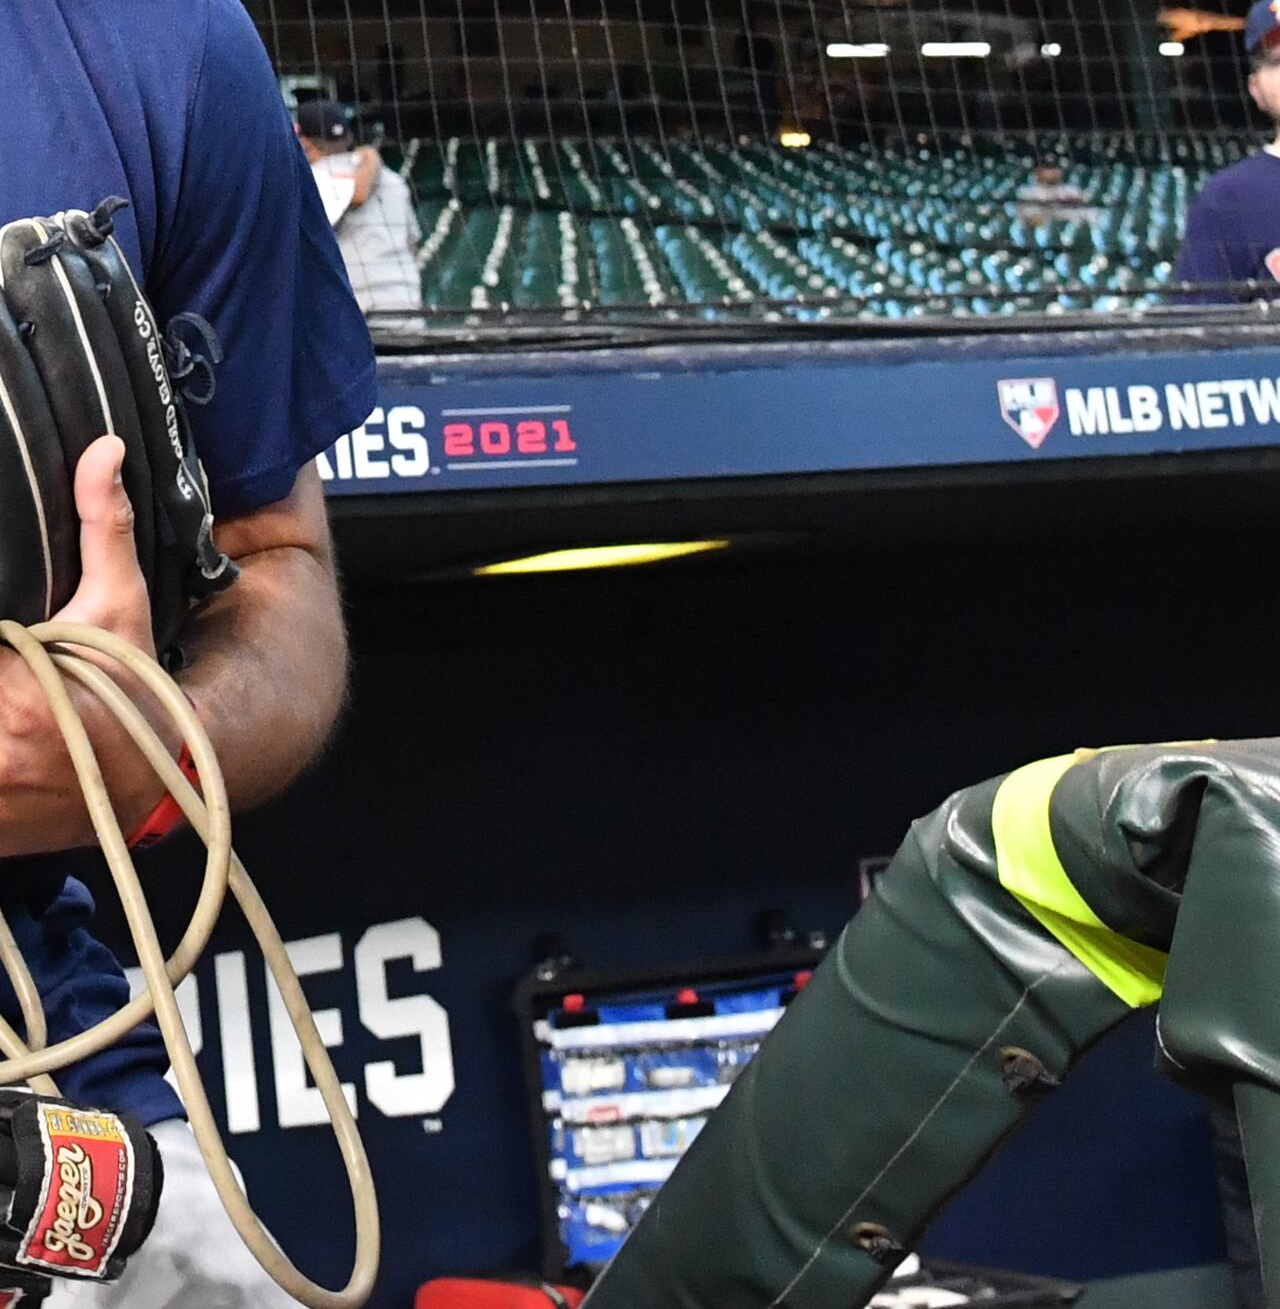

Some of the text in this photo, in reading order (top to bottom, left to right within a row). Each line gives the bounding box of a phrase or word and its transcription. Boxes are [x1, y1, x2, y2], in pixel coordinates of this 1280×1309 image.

[1064, 385, 1164, 437] MLB
[443, 419, 577, 457] 2021
[44, 1143, 104, 1262] Jaeger
